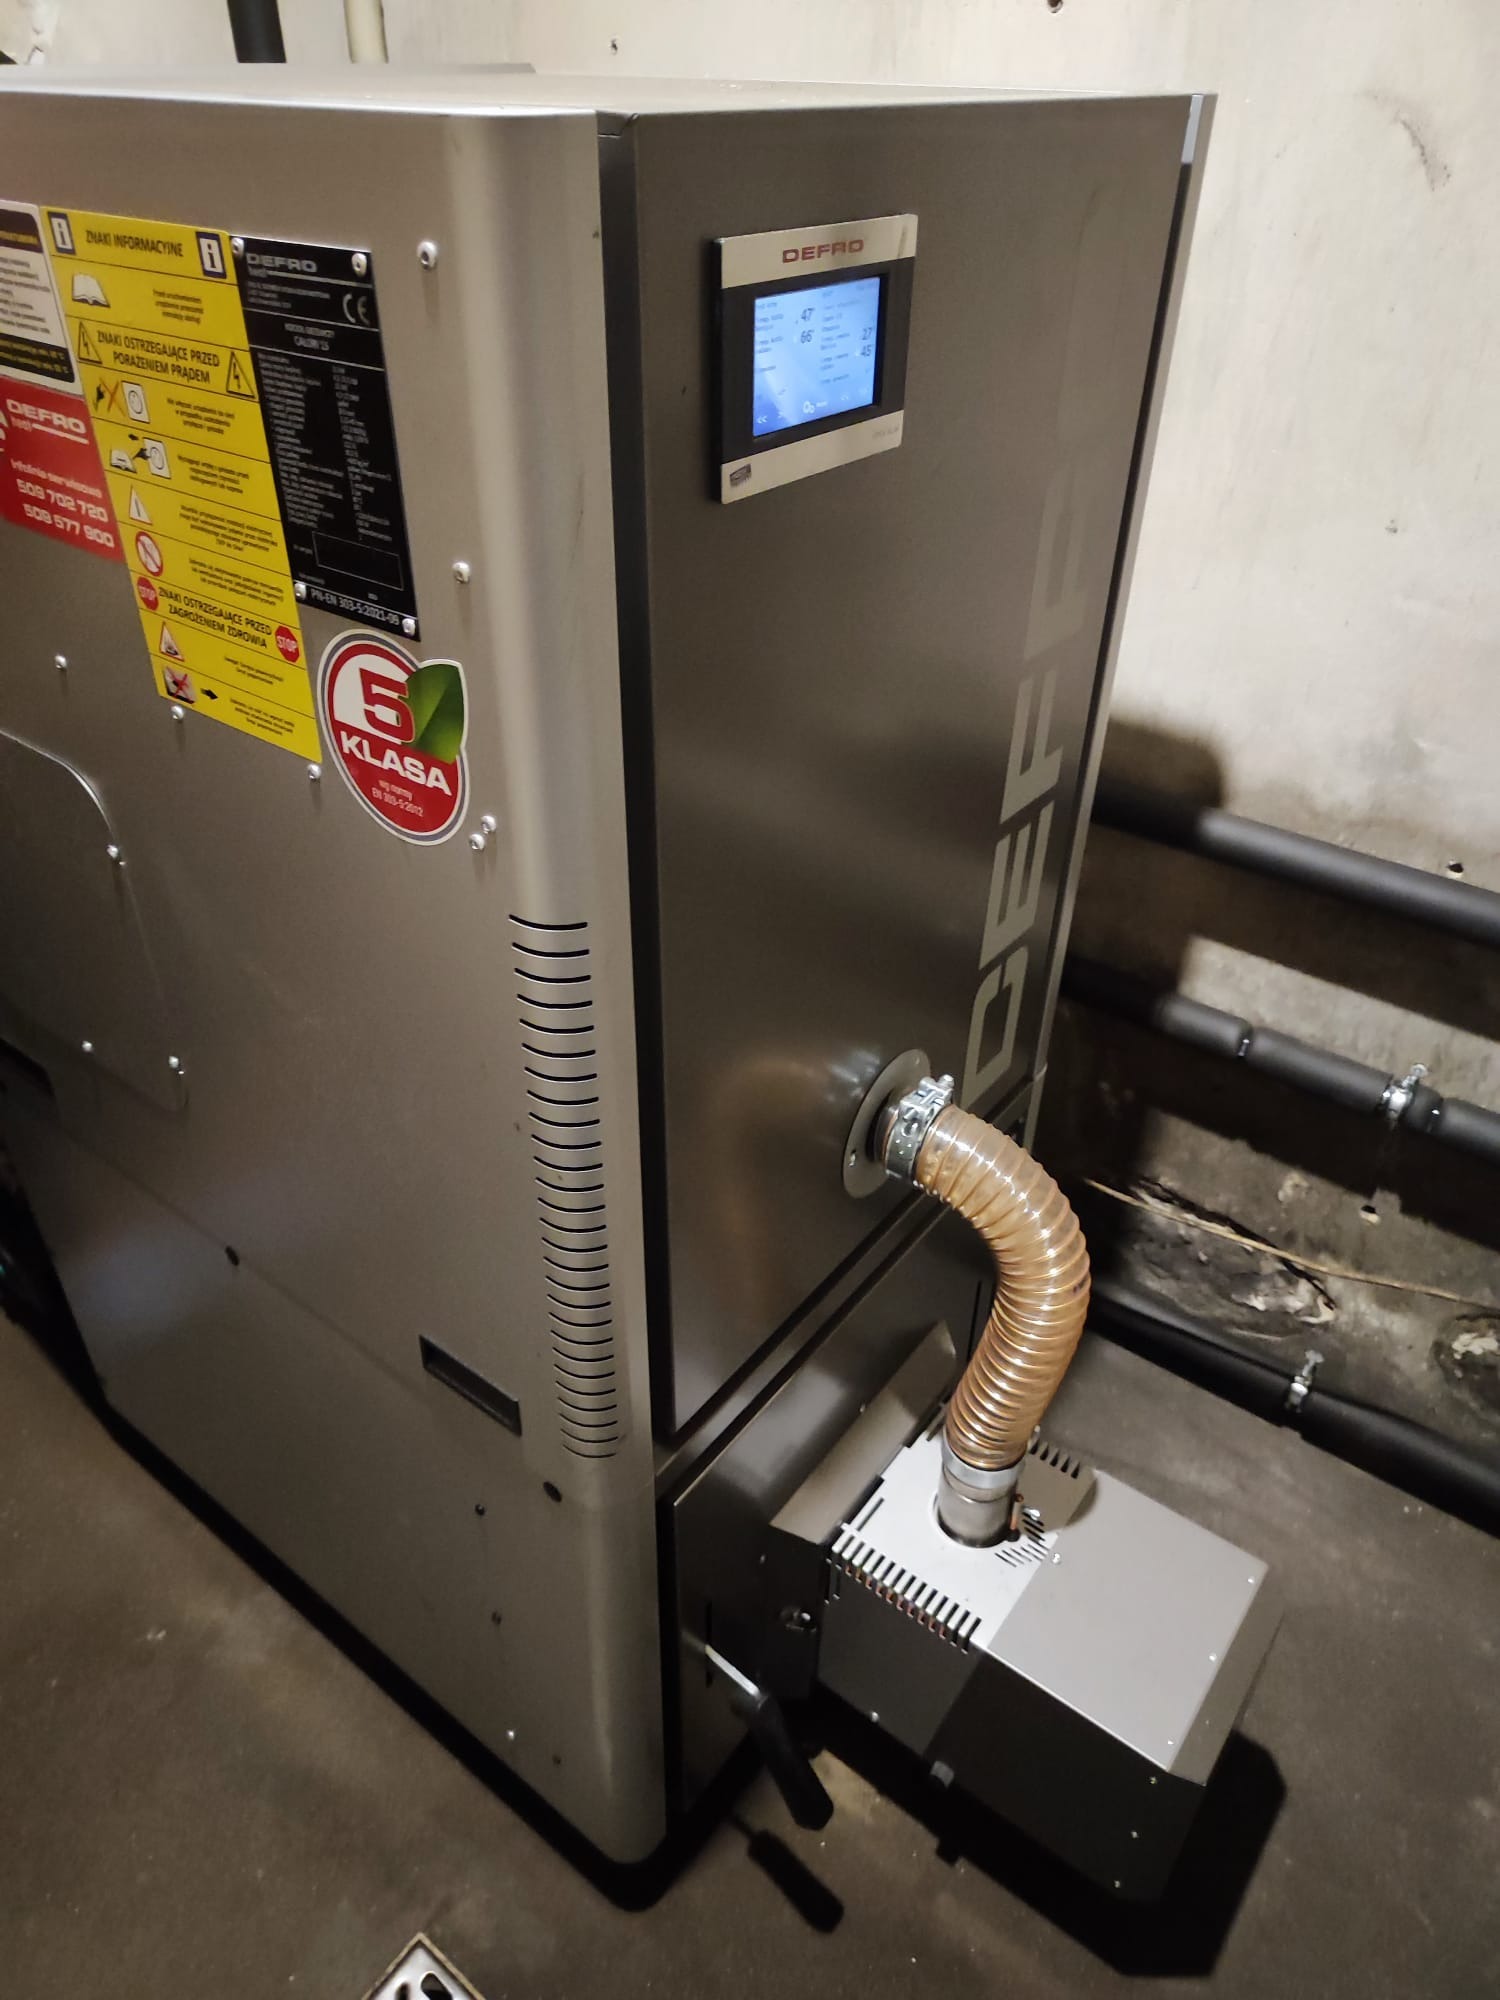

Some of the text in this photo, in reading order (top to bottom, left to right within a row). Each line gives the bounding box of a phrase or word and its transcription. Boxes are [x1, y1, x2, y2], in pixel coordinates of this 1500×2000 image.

[86, 230, 184, 257] ZNAKI INFORMACYJNE
[782, 239, 864, 264] DEFRO
[246, 253, 317, 273] DEFRO
[97, 330, 220, 367] ZNAKI OSTRZEGAJĄCE PRZED
[171, 365, 210, 384] PRĄDEM
[6, 400, 87, 435] DEFRO
[46, 490, 77, 511] 702
[78, 501, 109, 523] 720
[53, 514, 80, 535] 577
[83, 526, 115, 548] 900
[159, 587, 273, 636] ZNAKI OSTRZEGAJĄCE PRZED
[227, 627, 267, 649] ZDROWIA
[277, 635, 297, 652] STOP
[359, 668, 415, 744] 5
[340, 730, 453, 796] KLASA
